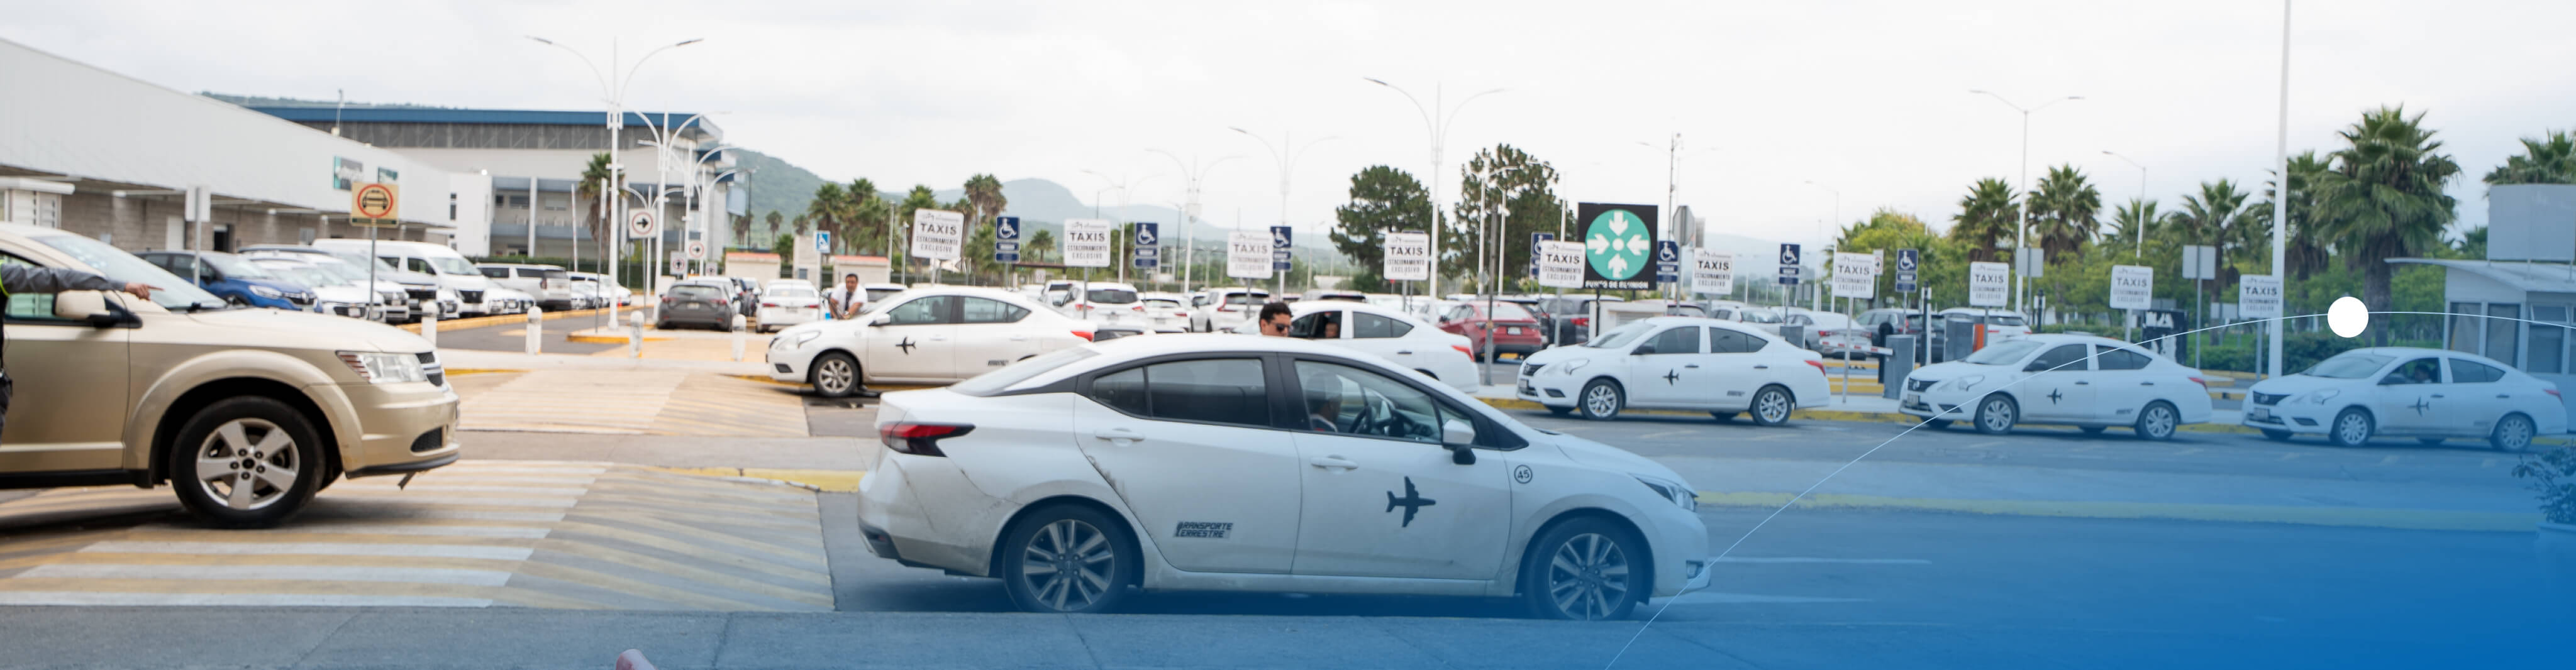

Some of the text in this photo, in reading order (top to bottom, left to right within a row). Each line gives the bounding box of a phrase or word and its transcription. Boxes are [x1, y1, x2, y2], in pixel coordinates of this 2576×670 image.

[920, 222, 957, 236] TAXIS
[1070, 232, 1105, 242] TAXIS
[1233, 244, 1268, 254] TAXIS
[1390, 246, 1423, 256] TAXIS
[1546, 254, 1580, 264] TAXIS
[1698, 260, 1729, 270] TAXIS
[1838, 265, 1870, 275] TAXIS
[1975, 274, 2004, 284] TAXIS
[2117, 277, 2147, 287] TAXIS
[2245, 286, 2277, 296] TAXIS
[1518, 469, 1530, 479] 45
